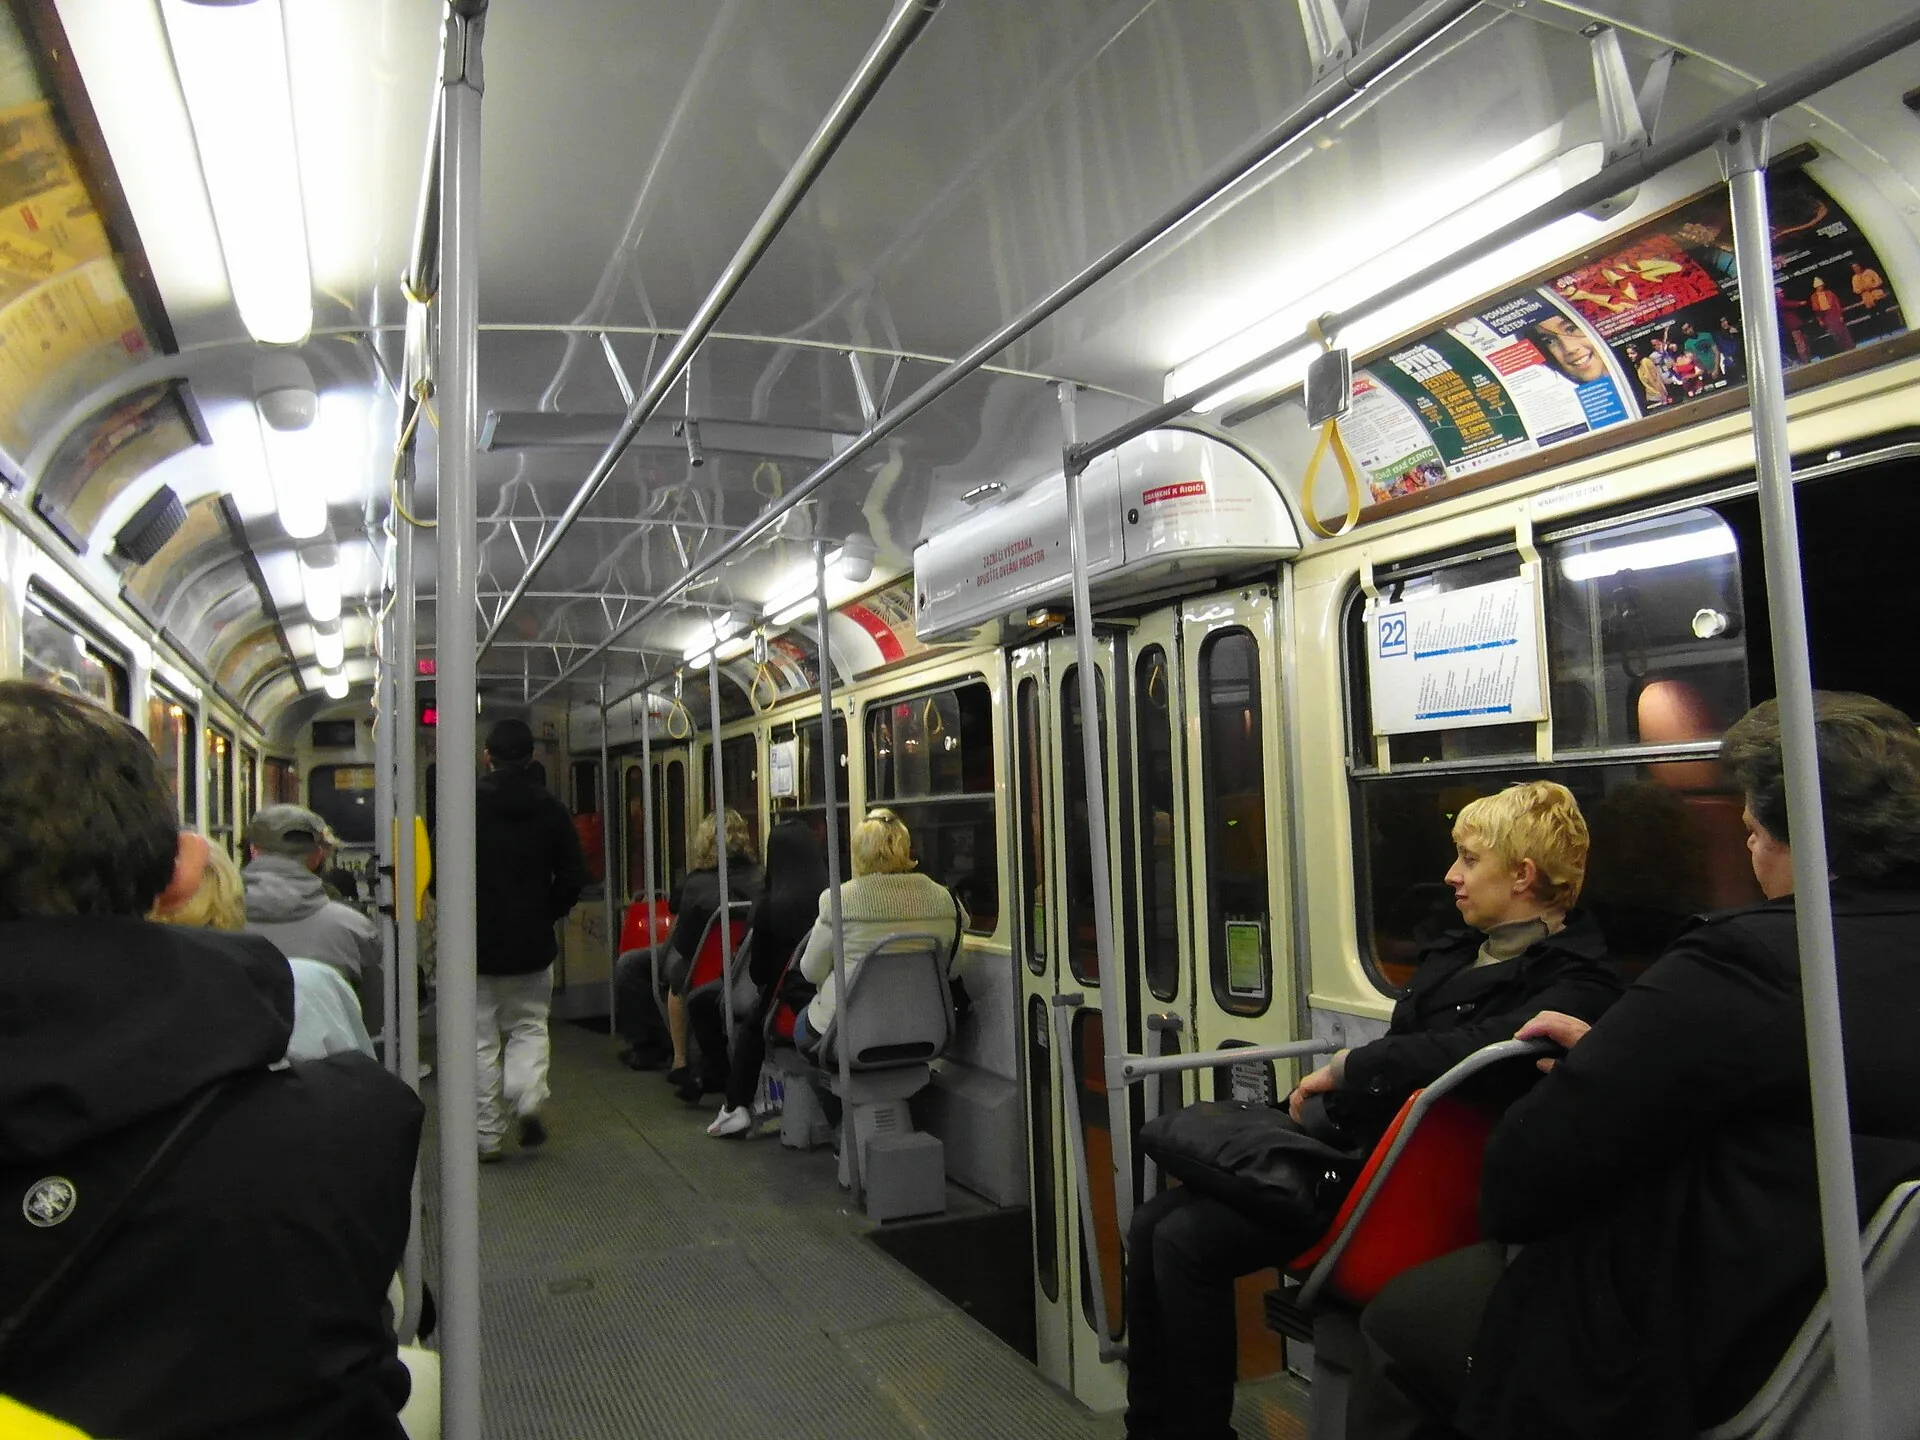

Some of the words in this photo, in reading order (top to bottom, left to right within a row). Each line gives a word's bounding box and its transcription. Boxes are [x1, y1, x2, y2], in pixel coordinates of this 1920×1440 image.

[1482, 298, 1528, 321] POMÁHÁME
[1499, 319, 1527, 334] DĚTEM
[1395, 348, 1443, 375] PIVO
[1421, 370, 1461, 390] FESTIVAL
[1179, 484, 1204, 494] ŘIDIČI
[1019, 549, 1045, 569] PROSTOR
[1381, 620, 1405, 648] 22
